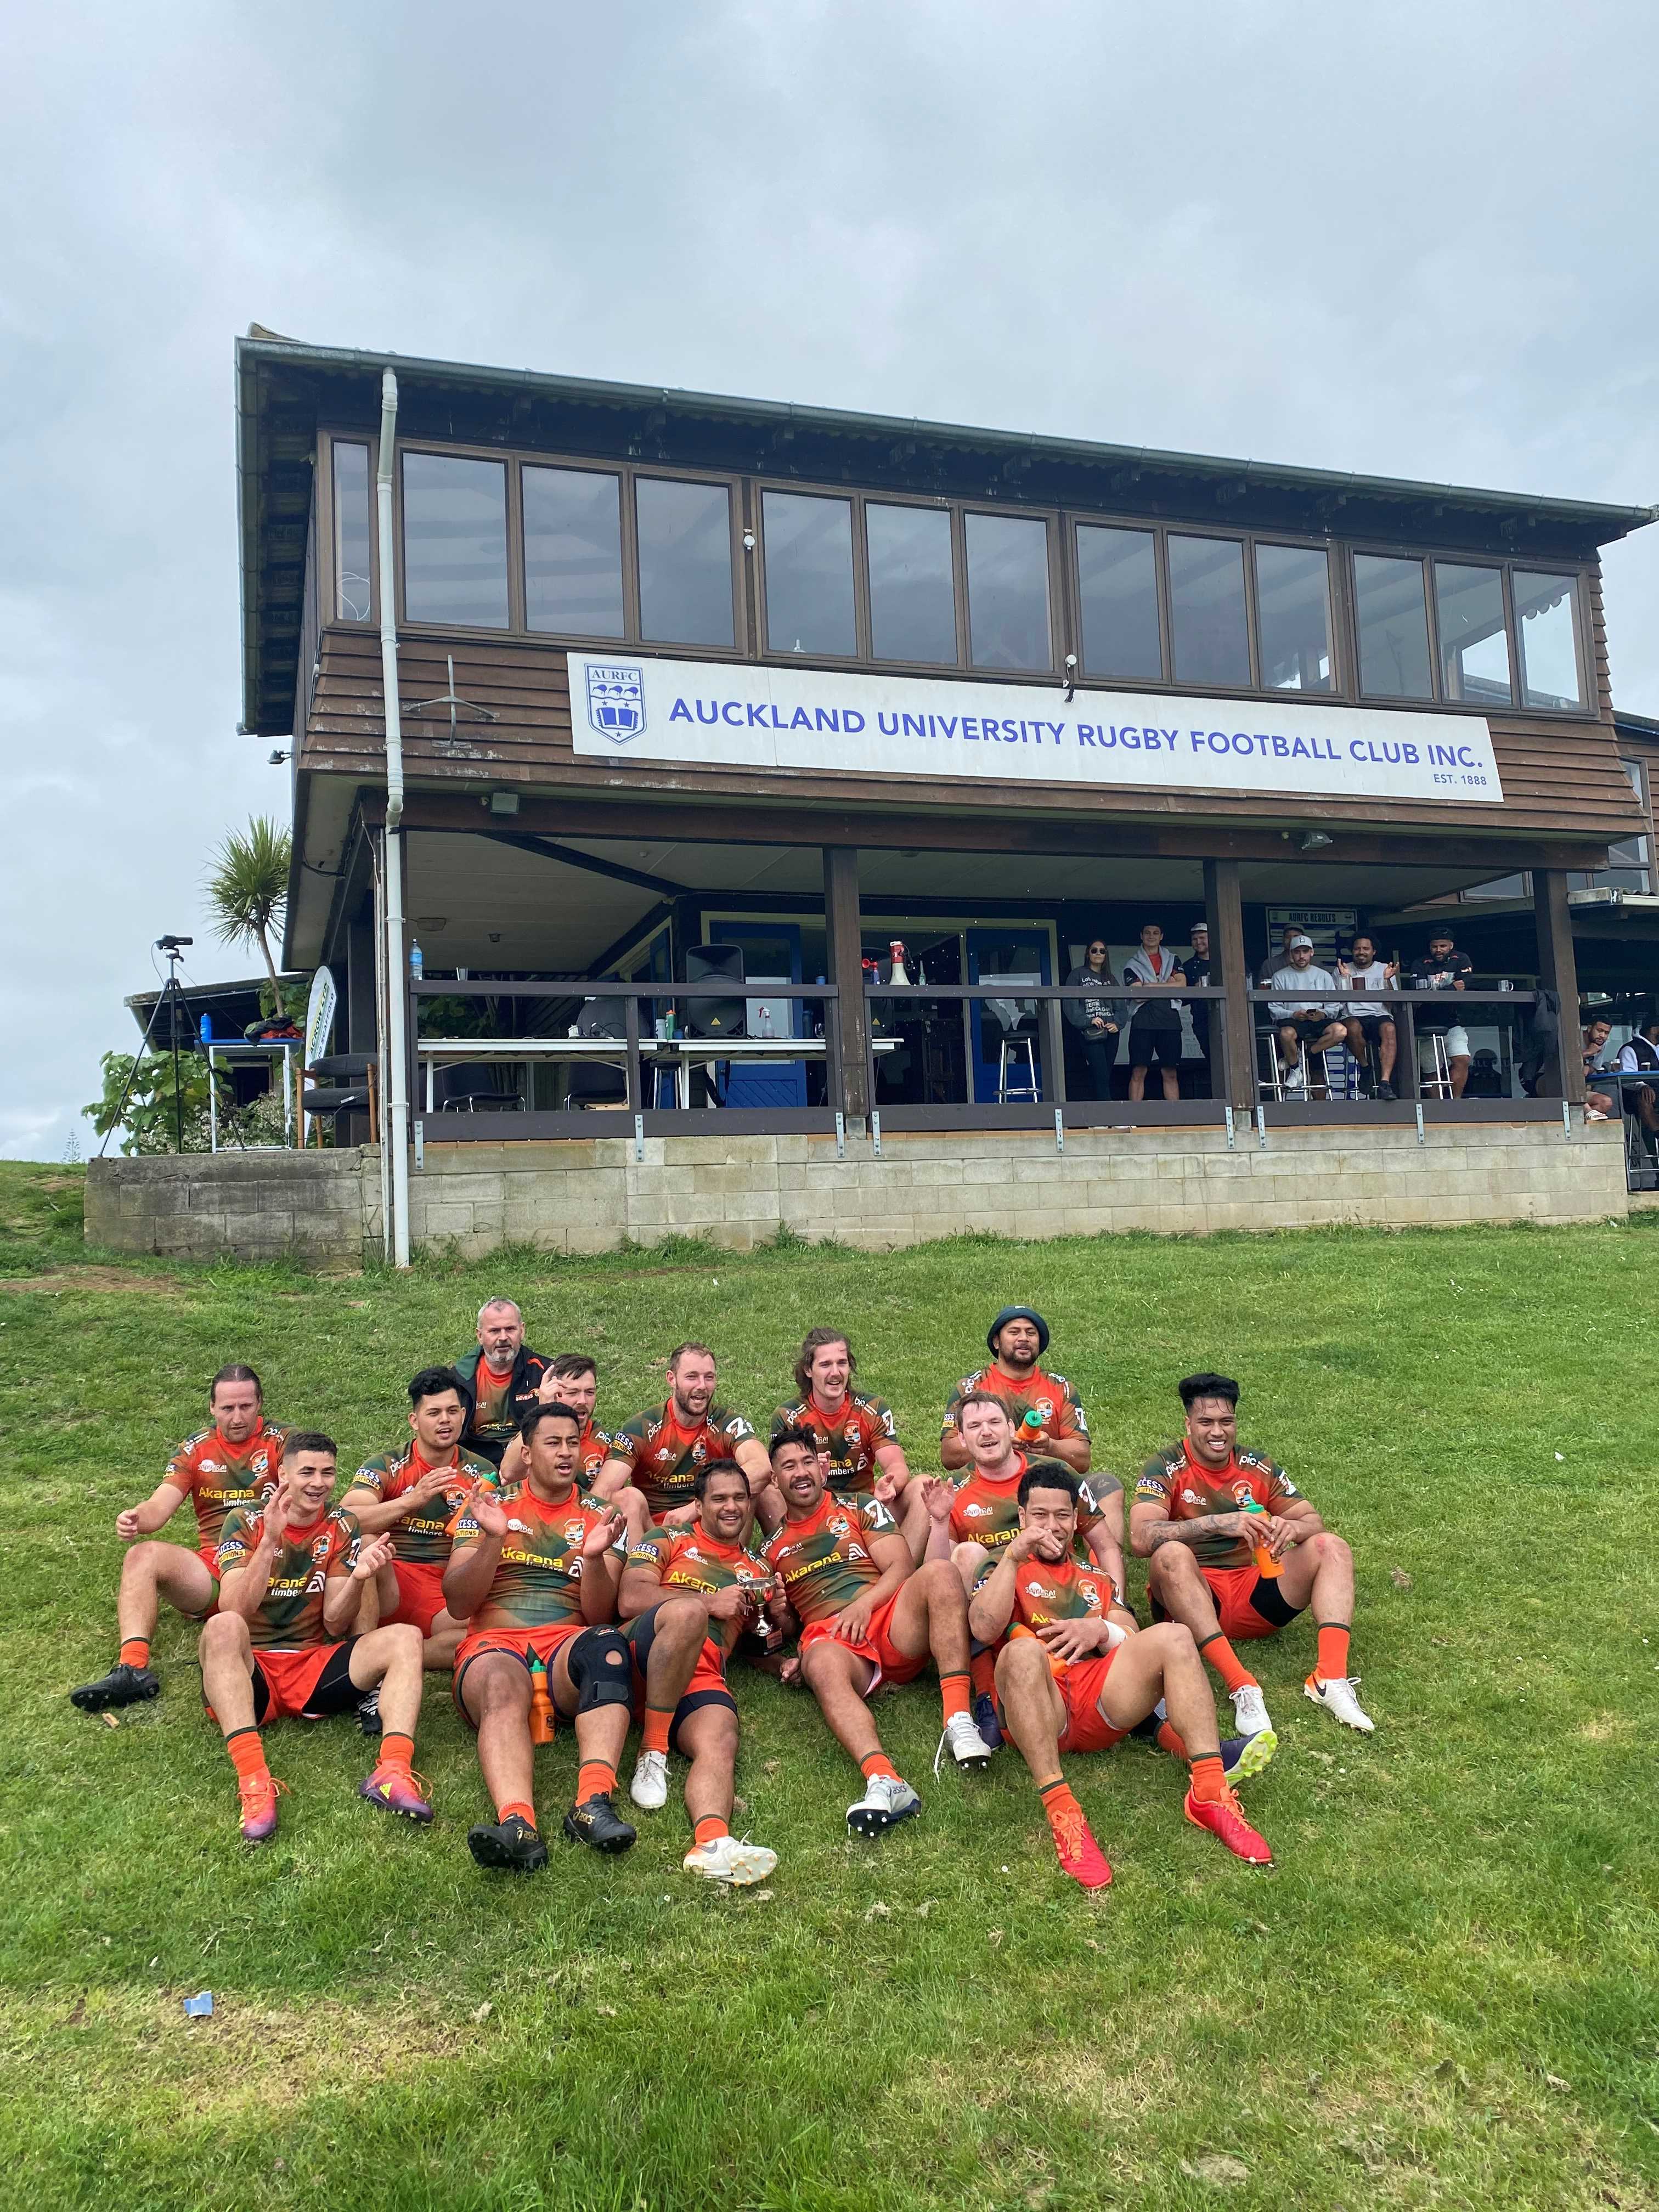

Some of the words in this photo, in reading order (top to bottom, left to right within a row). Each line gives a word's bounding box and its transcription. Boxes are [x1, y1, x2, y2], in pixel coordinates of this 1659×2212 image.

[592, 670, 637, 681] AURFC
[669, 698, 866, 733] AUCKLAND
[878, 711, 1066, 745] UNIVERSITY
[1077, 724, 1179, 752] RUGBY
[1190, 730, 1342, 760] FOOTBALL
[1349, 739, 1420, 764] CLUB
[1427, 744, 1483, 768] INC.
[1434, 774, 1458, 784] EST.
[1461, 775, 1487, 785] 1888
[1310, 913, 1336, 923] RESULTS
[614, 1431, 634, 1450] CCESS
[1239, 1453, 1257, 1466] pic
[356, 1468, 380, 1483] CCESS
[1136, 1478, 1164, 1492] CCESS
[199, 1487, 255, 1499] Akarana
[400, 1516, 445, 1531] arana
[456, 1519, 478, 1530] CCESS
[785, 1551, 843, 1584] Akarana
[267, 1577, 307, 1588] arana
[668, 1571, 721, 1595] Akara
